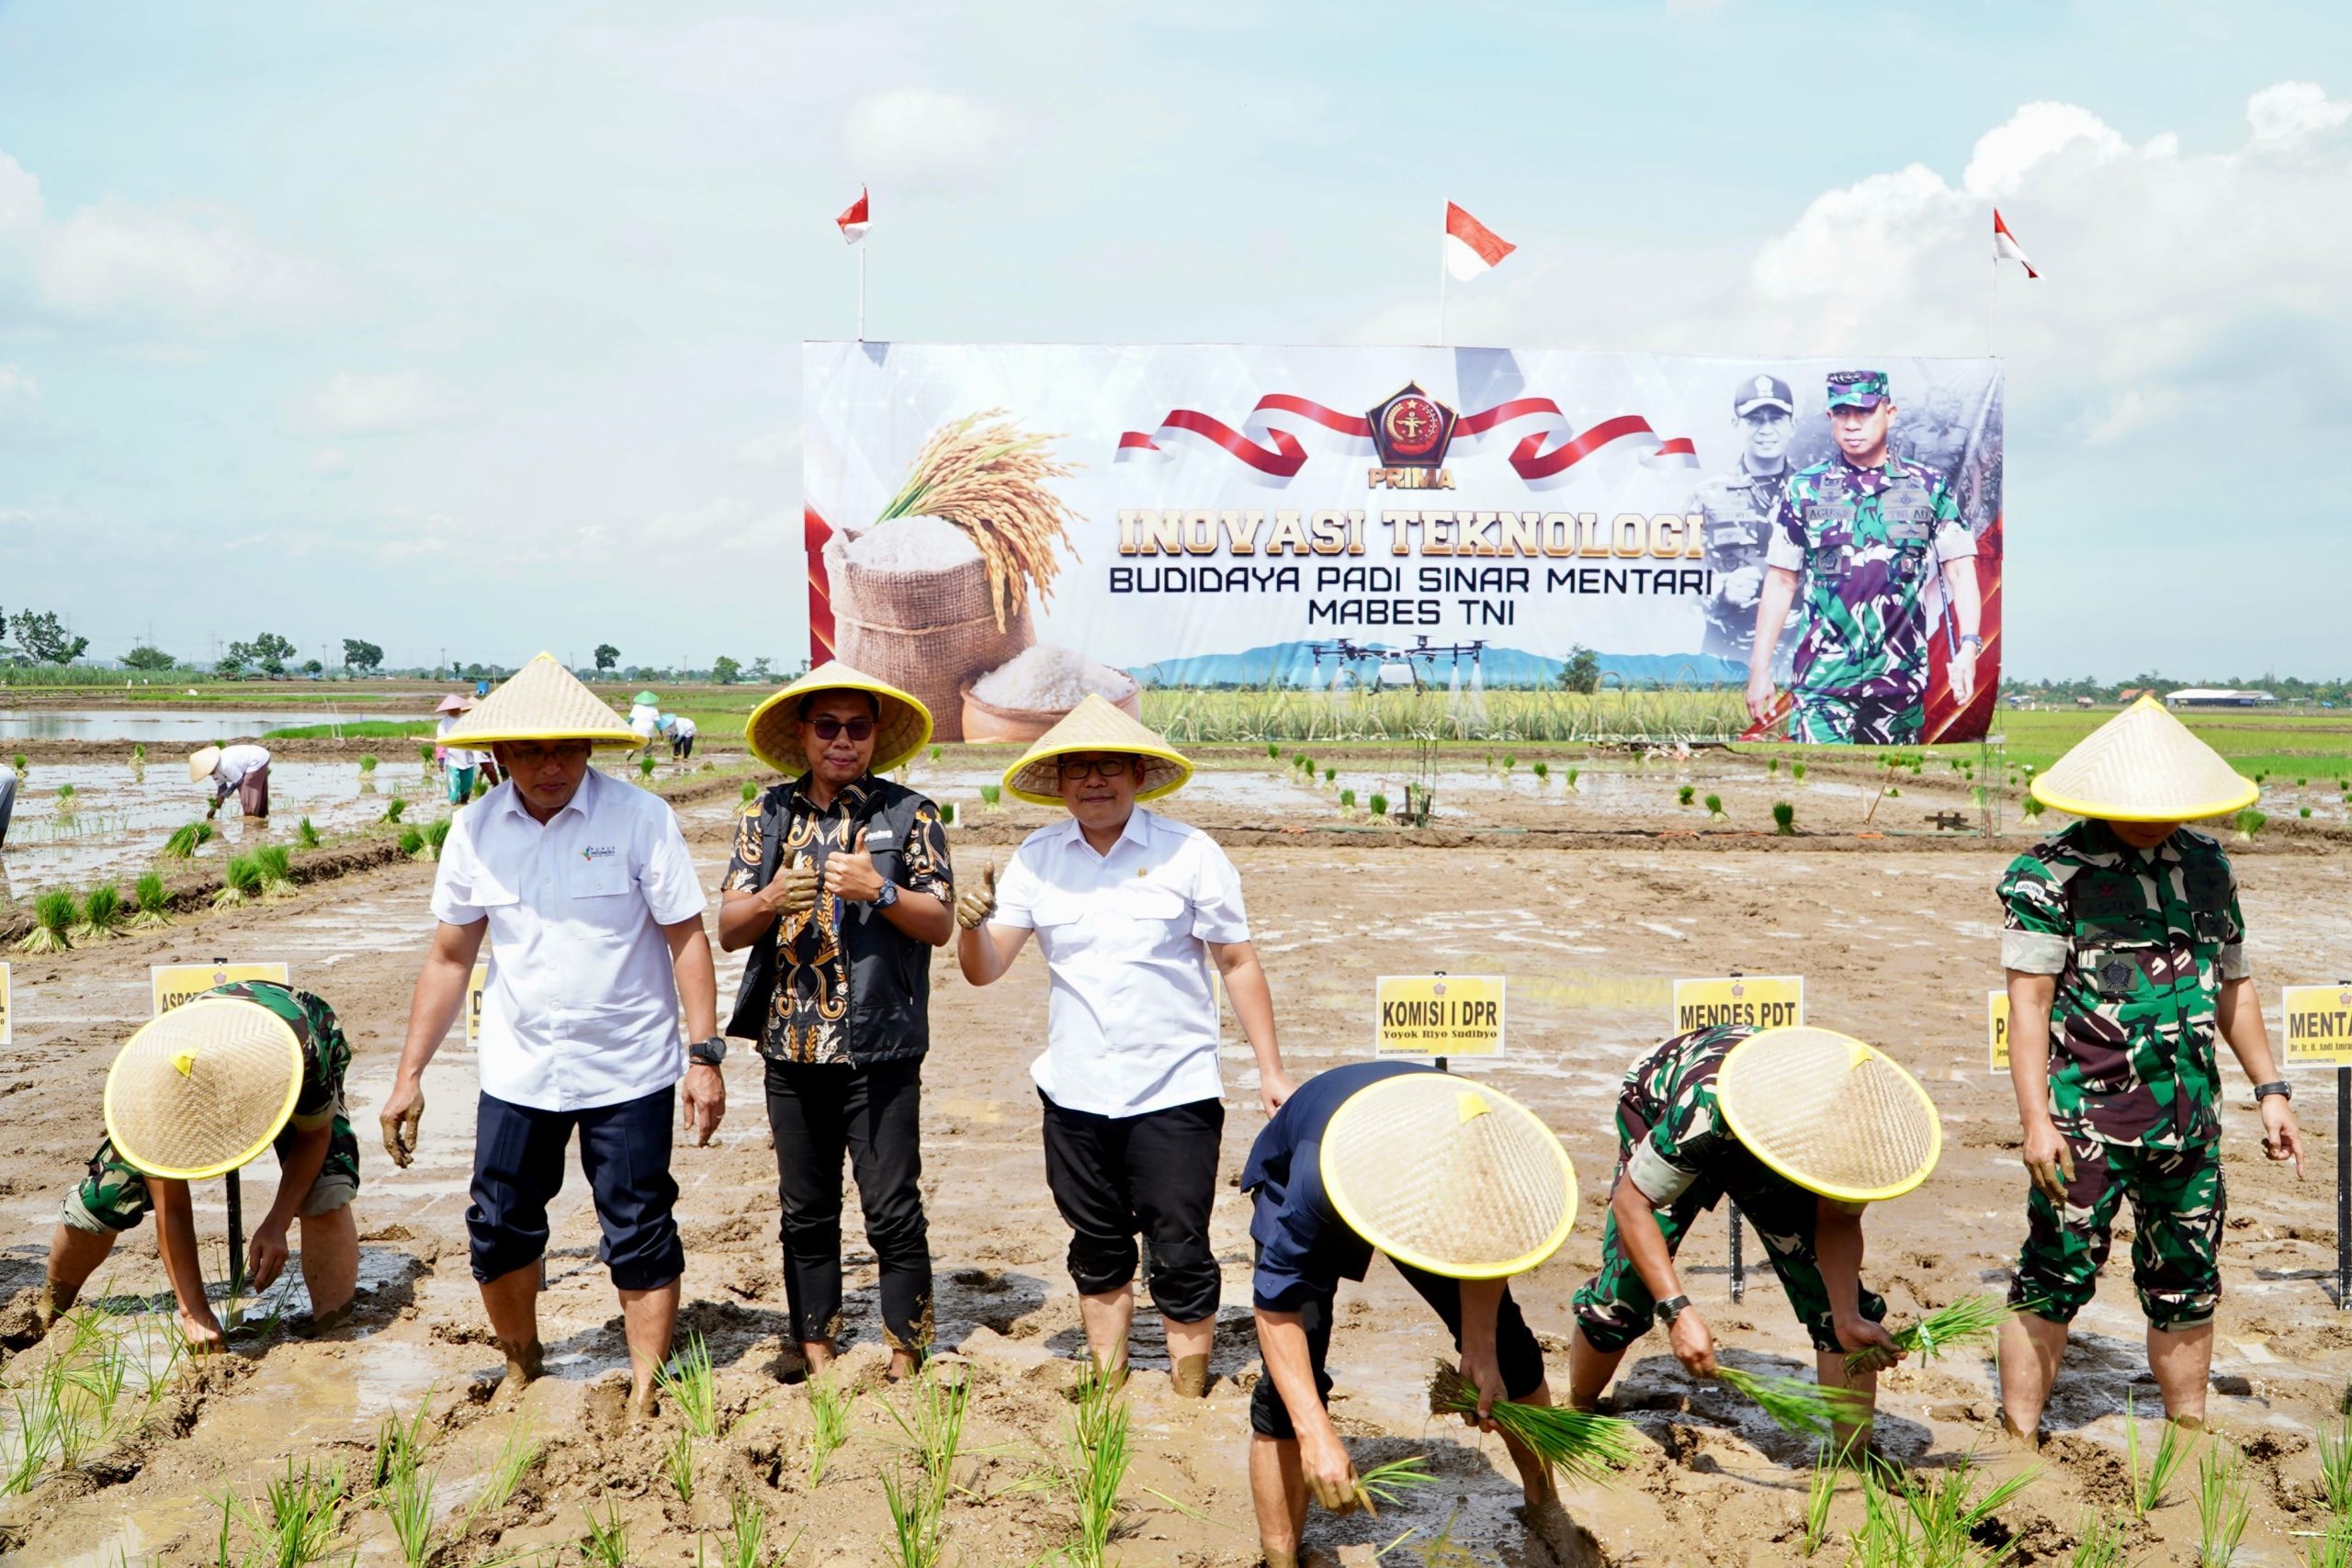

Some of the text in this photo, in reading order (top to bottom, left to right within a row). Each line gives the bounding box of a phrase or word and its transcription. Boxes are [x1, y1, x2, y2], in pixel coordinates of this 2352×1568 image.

[1368, 468, 1455, 490] PRIMA
[1117, 509, 1705, 559] INOVASI TEKNOLOGI
[1110, 567, 1713, 595] BUDIDAYA PADI SINAR MENTARI
[1308, 599, 1515, 626] MABES TNI
[1383, 1000, 1498, 1027] KOMISI I DPR
[1680, 1001, 1796, 1029] MENDES PDT
[1384, 1030, 1498, 1040] Yoyok Riyo Sudibyo
[2319, 1043, 2334, 1051] Andi
